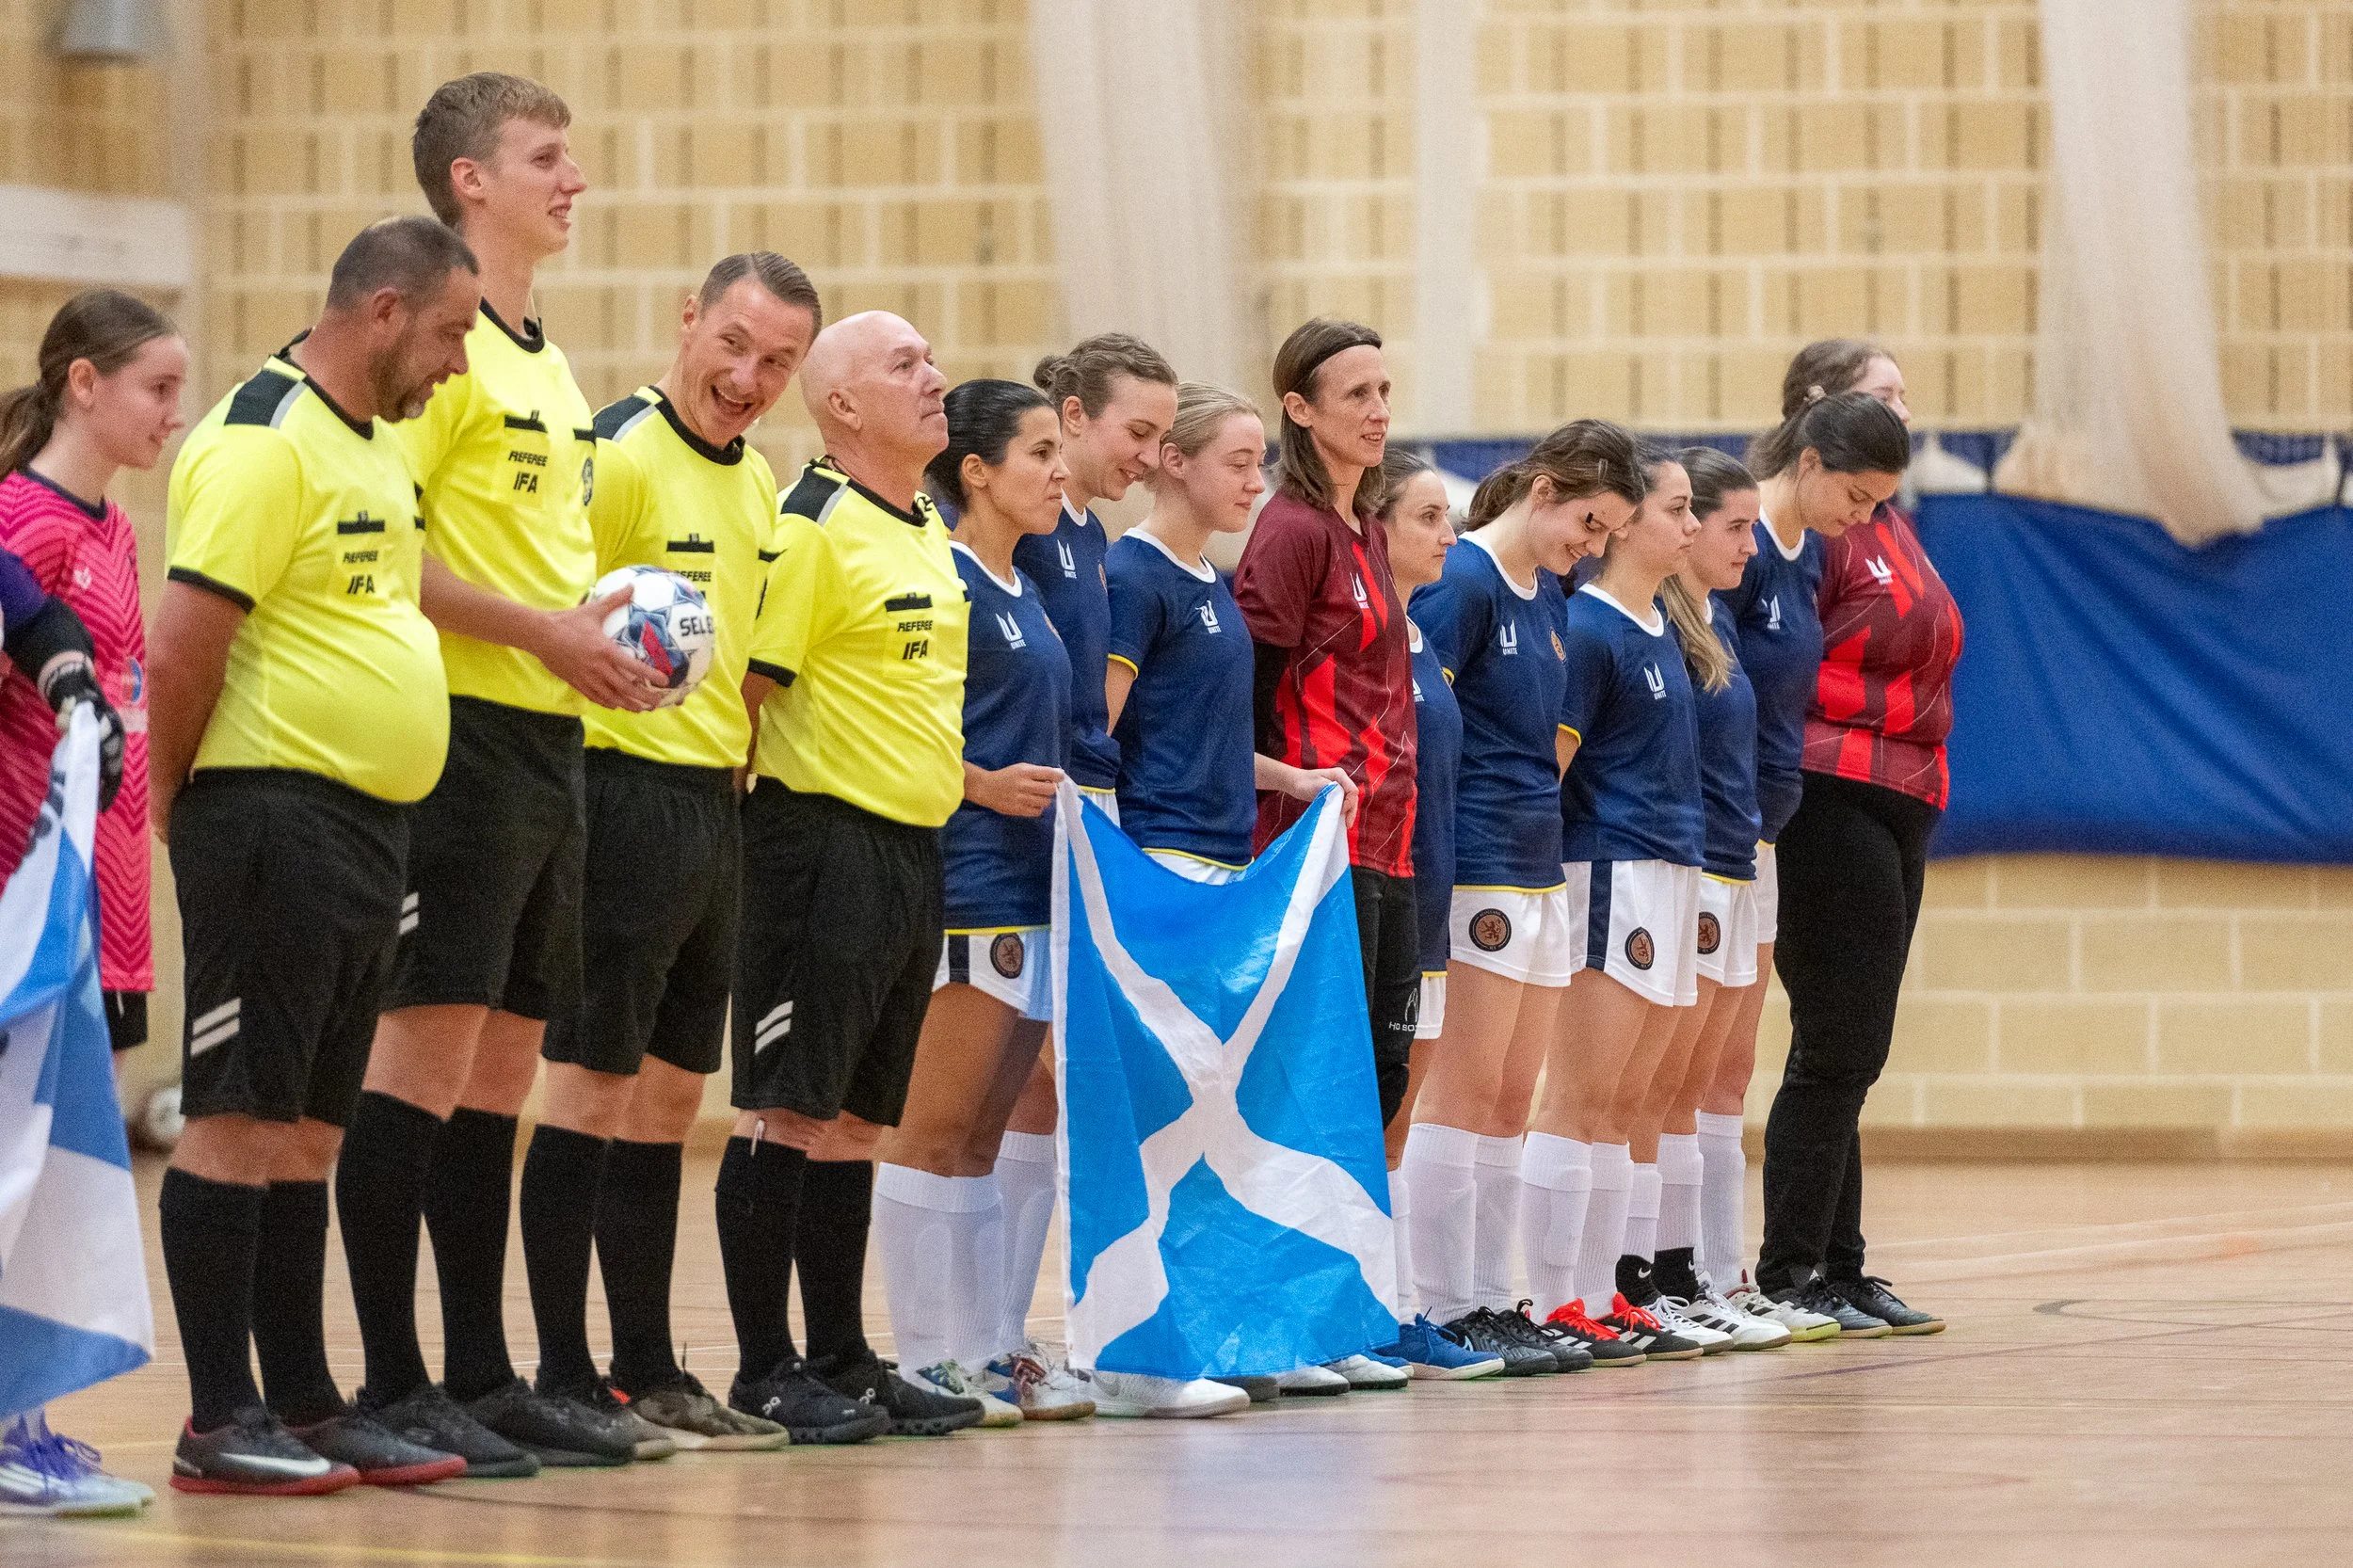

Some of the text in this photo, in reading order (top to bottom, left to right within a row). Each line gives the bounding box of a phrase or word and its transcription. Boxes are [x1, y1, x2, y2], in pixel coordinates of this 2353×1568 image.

[508, 450, 548, 467] REFEREE
[513, 471, 538, 493] IFA
[347, 574, 376, 595] IFA
[897, 619, 933, 632] REFEREE
[903, 639, 928, 660] IFA
[1502, 647, 1518, 656] UNITE
[1402, 1023, 1417, 1032] SO
